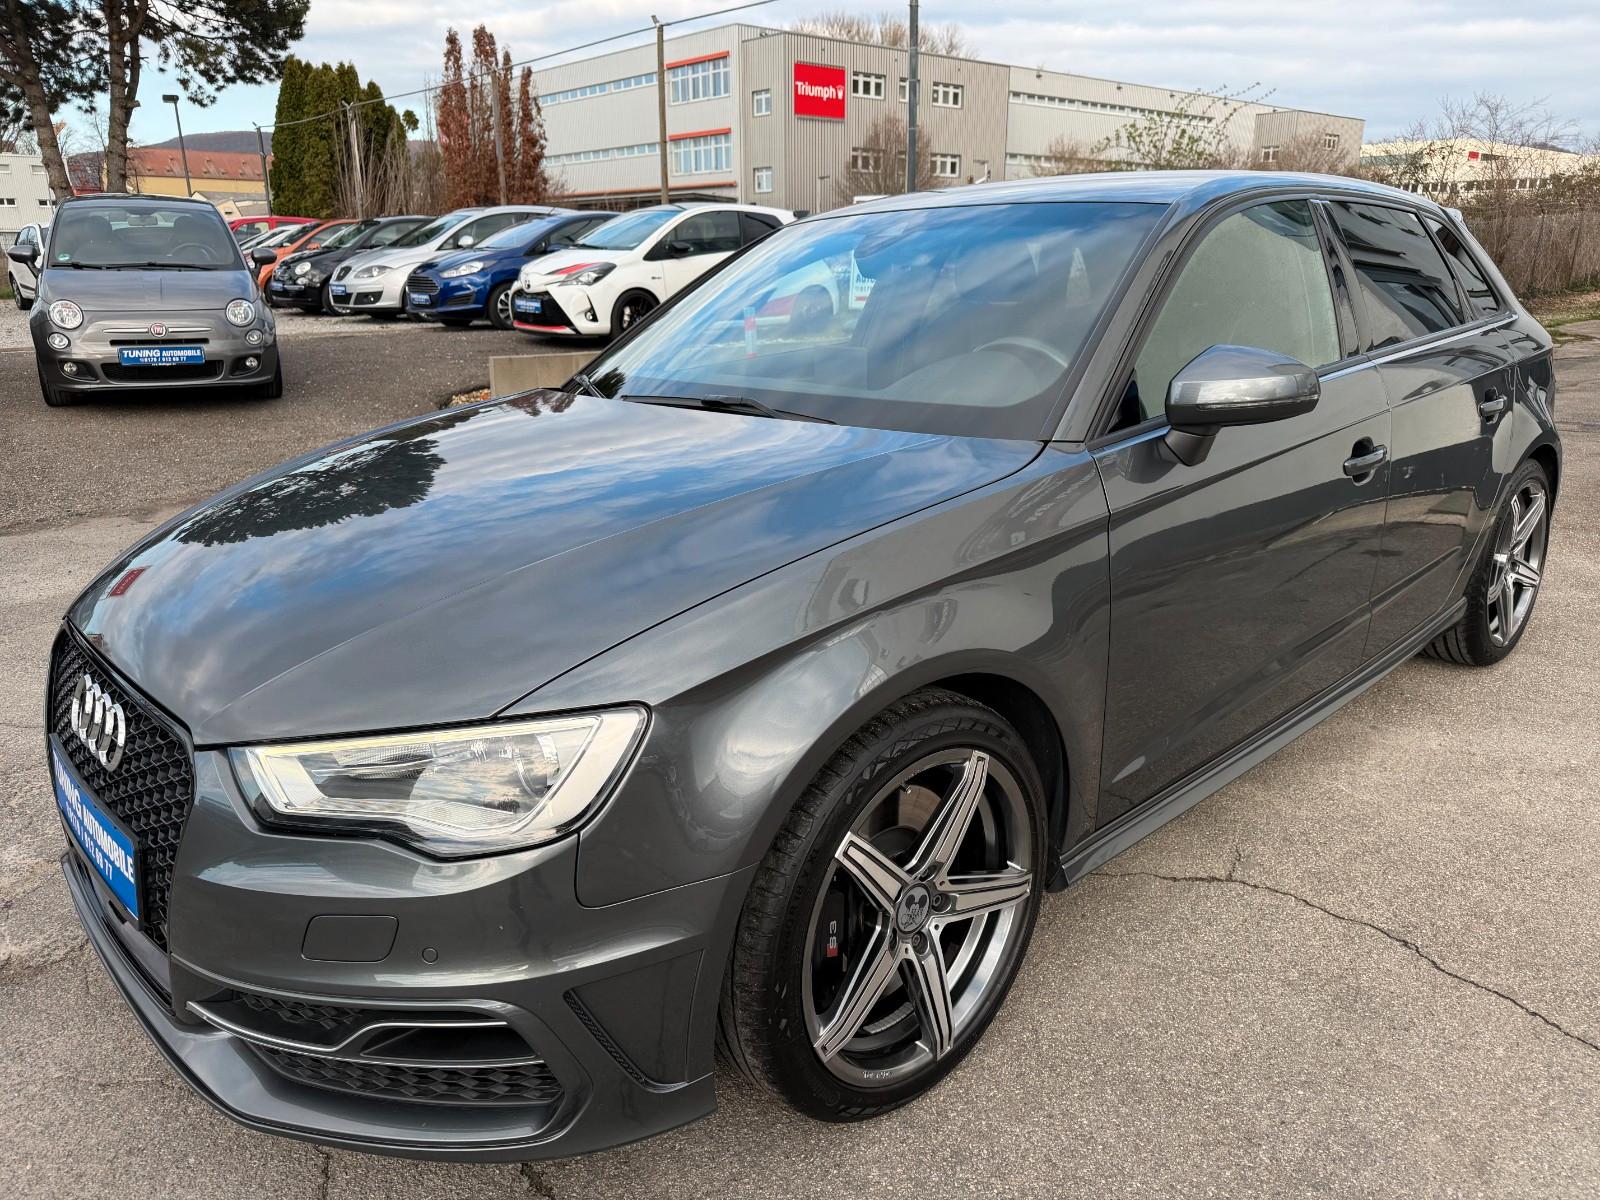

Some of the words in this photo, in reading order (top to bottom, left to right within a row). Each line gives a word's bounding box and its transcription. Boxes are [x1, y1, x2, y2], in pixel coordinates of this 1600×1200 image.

[795, 81, 836, 101] Triumph
[122, 349, 160, 358] TUNING
[162, 349, 201, 357] AUTOMOBILE
[53, 749, 82, 820] TUNING
[83, 803, 135, 884] AUTOMOBILE
[105, 859, 112, 880] 77
[829, 920, 837, 949] S3
